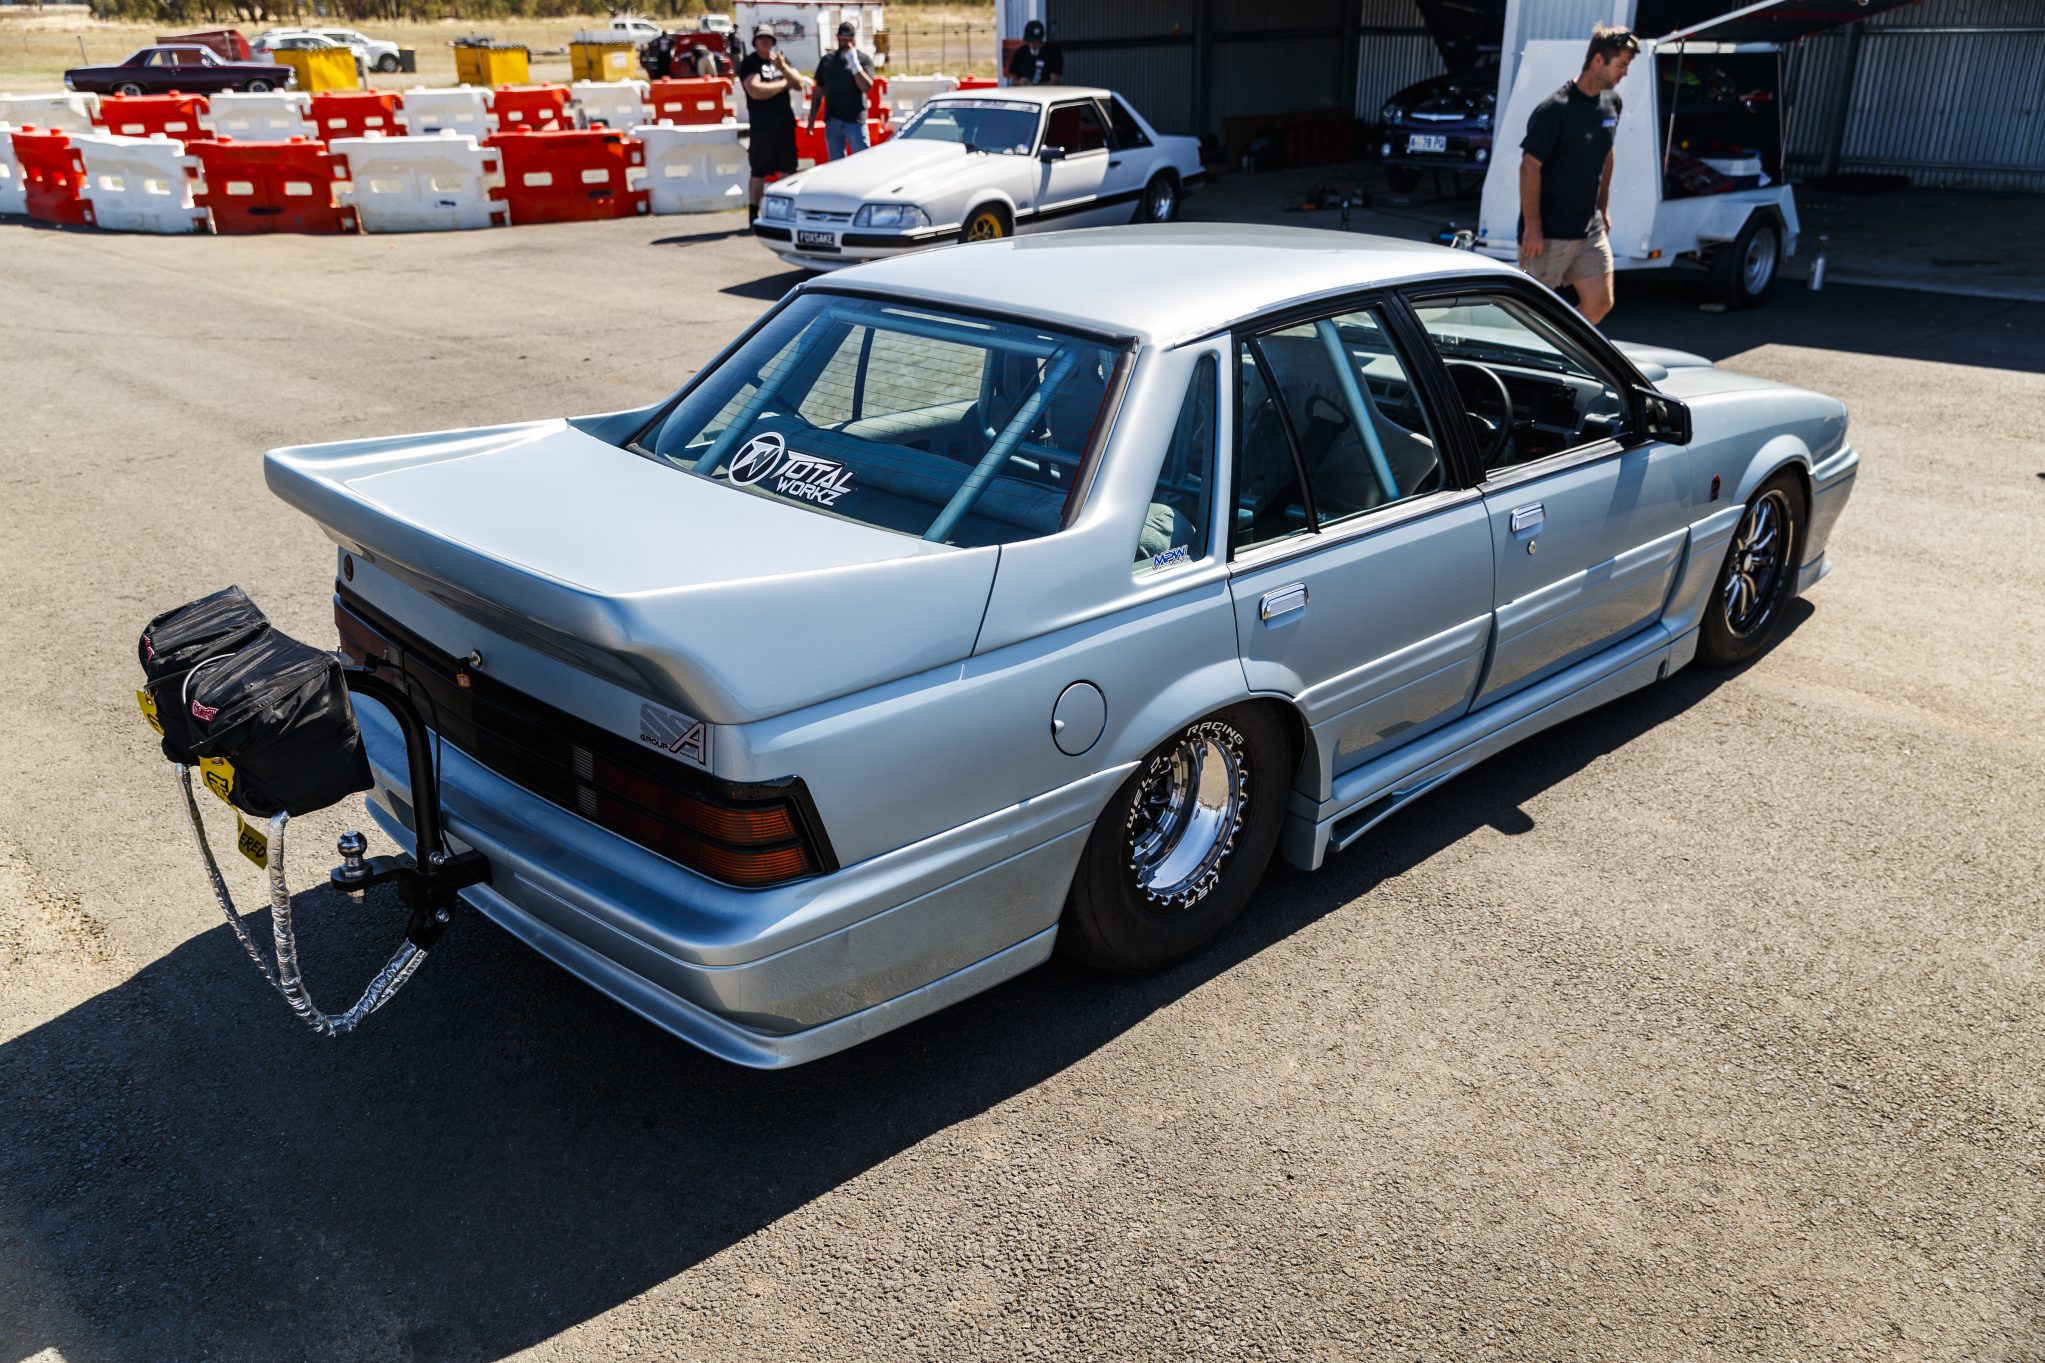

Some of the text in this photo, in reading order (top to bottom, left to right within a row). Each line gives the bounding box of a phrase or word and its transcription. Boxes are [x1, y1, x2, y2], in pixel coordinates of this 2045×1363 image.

[799, 232, 834, 245] FOXSAKE
[770, 450, 853, 494] TOTAL
[776, 476, 843, 507] WORKZ
[640, 720, 707, 766] GROUP A
[1187, 721, 1245, 745] RACING
[1183, 874, 1220, 910] USA
